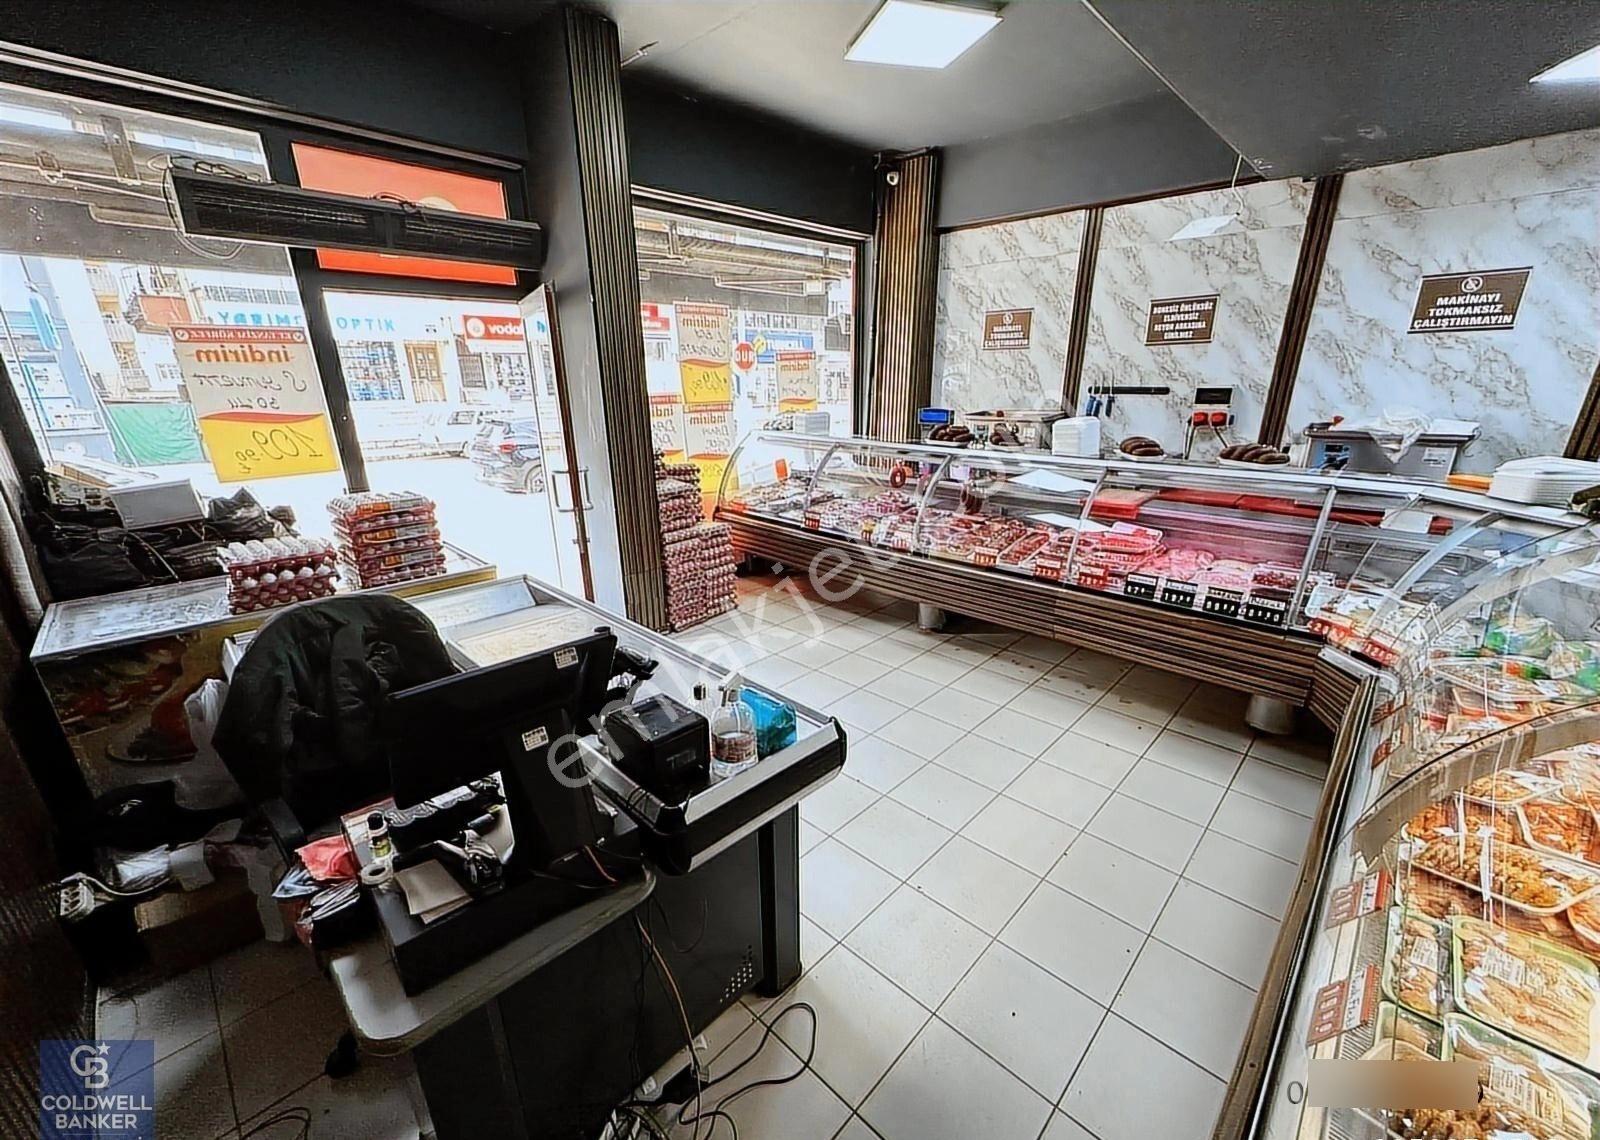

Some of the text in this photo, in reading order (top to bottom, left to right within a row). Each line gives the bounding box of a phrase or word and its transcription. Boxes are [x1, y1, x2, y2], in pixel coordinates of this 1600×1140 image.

[1436, 292, 1500, 306] MAKİNAYI
[1428, 304, 1503, 317] TOKMAKSIZ
[1413, 314, 1514, 328] ÇALIŞTIRMAYIN
